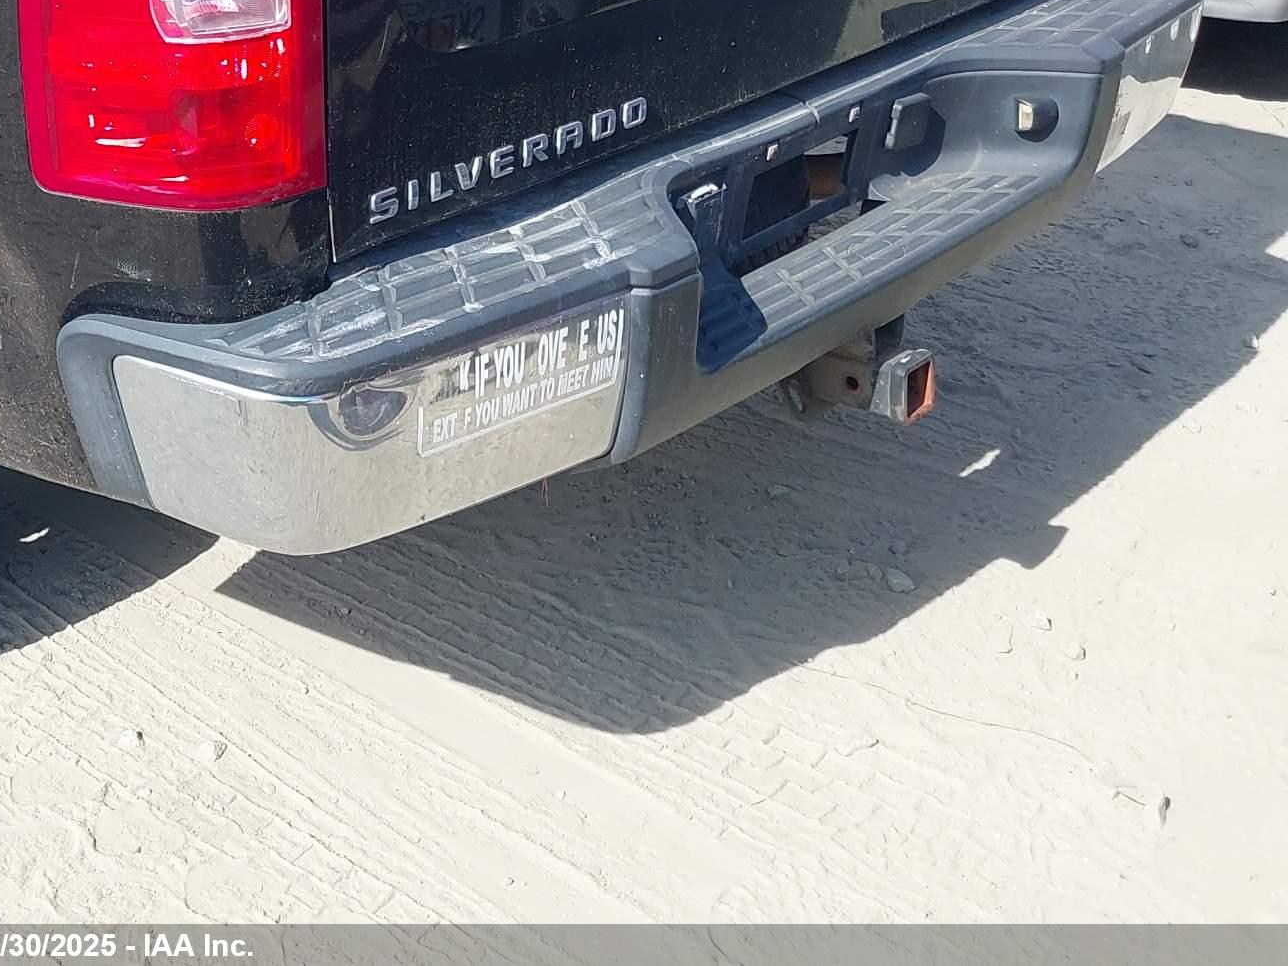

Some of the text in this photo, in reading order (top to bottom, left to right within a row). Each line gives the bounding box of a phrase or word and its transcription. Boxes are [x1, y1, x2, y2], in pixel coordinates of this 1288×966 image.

[369, 96, 648, 225] SILVERADO
[475, 353, 489, 399] IF
[494, 341, 526, 389] YOU
[537, 326, 569, 376] OVE
[432, 412, 458, 443] EXT
[475, 397, 500, 427] YOU
[502, 383, 538, 418] WANT
[540, 378, 555, 404] TO
[557, 364, 590, 397] MEET
